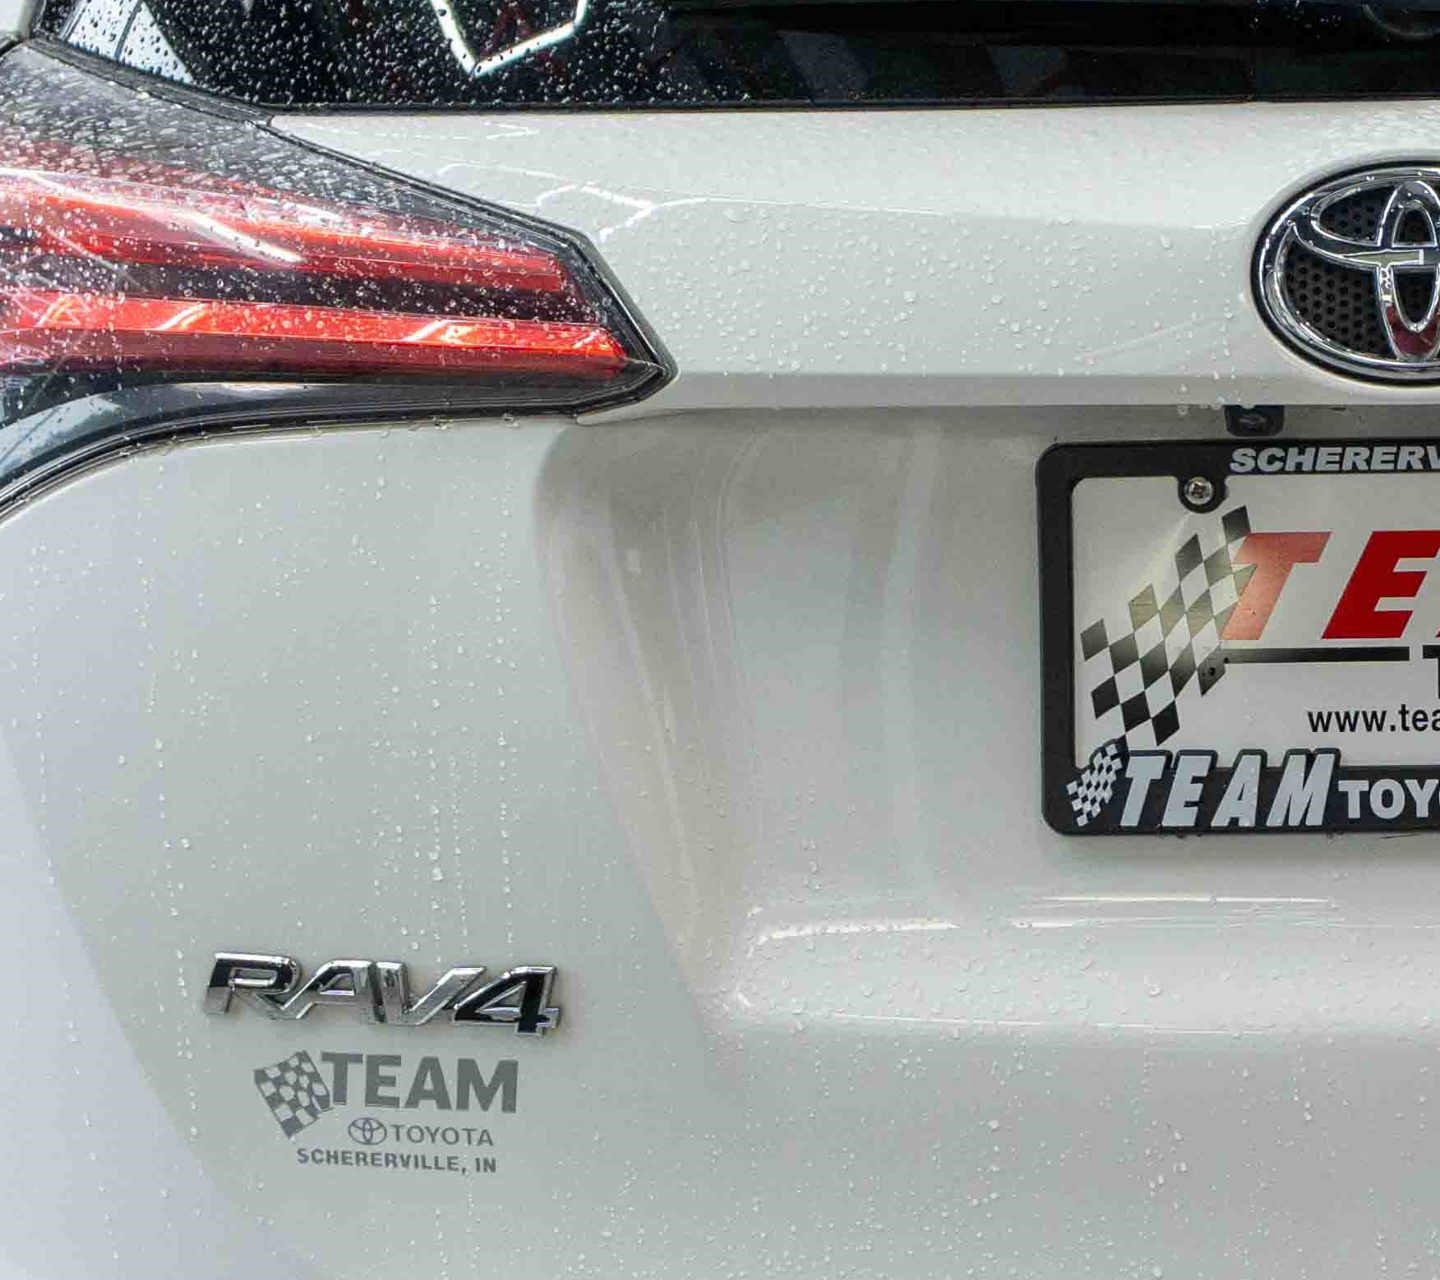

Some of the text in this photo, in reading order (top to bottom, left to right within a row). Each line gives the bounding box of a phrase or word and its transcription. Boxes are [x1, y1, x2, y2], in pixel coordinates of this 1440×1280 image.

[1119, 753, 1337, 828] TEAM
[201, 951, 561, 1038] RAV4
[320, 1051, 520, 1114] TEAM
[296, 1147, 498, 1175] SCHERERVILLE, IN
[391, 1123, 494, 1147] TOYOTA
